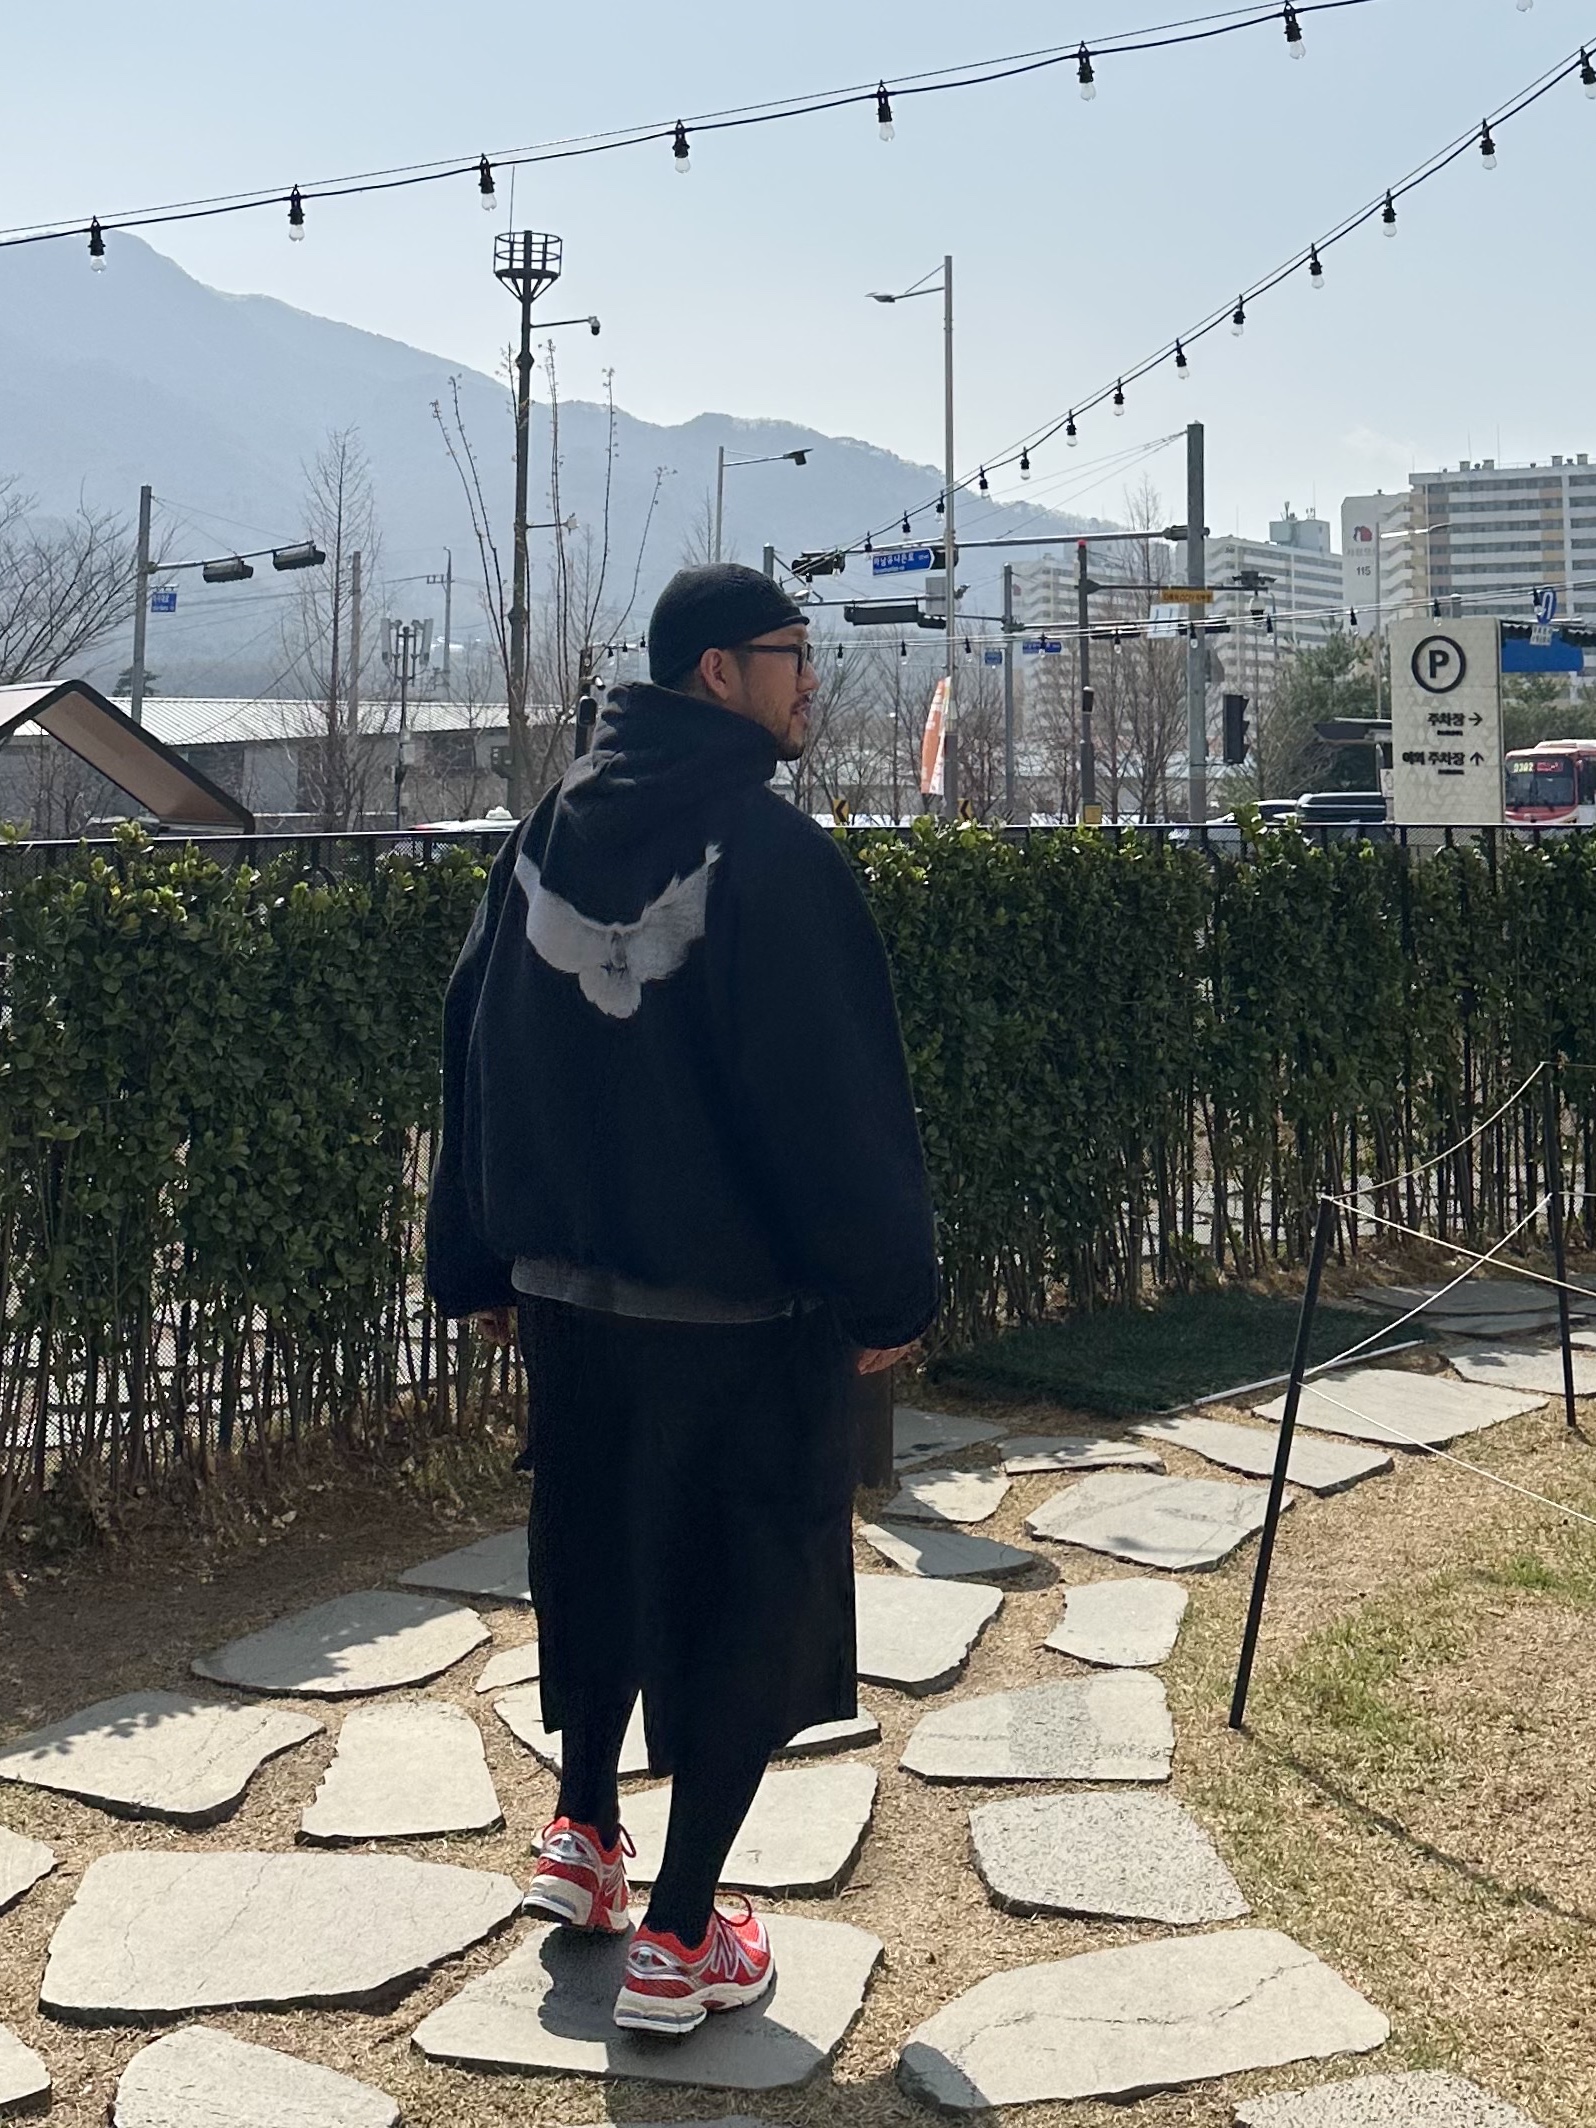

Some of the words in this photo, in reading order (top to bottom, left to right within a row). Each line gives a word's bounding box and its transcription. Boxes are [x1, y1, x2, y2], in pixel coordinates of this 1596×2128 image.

[1356, 565, 1371, 576] 115
[1428, 649, 1449, 679] P
[1427, 712, 1465, 726] 주차장
[1428, 751, 1465, 766] 주차장
